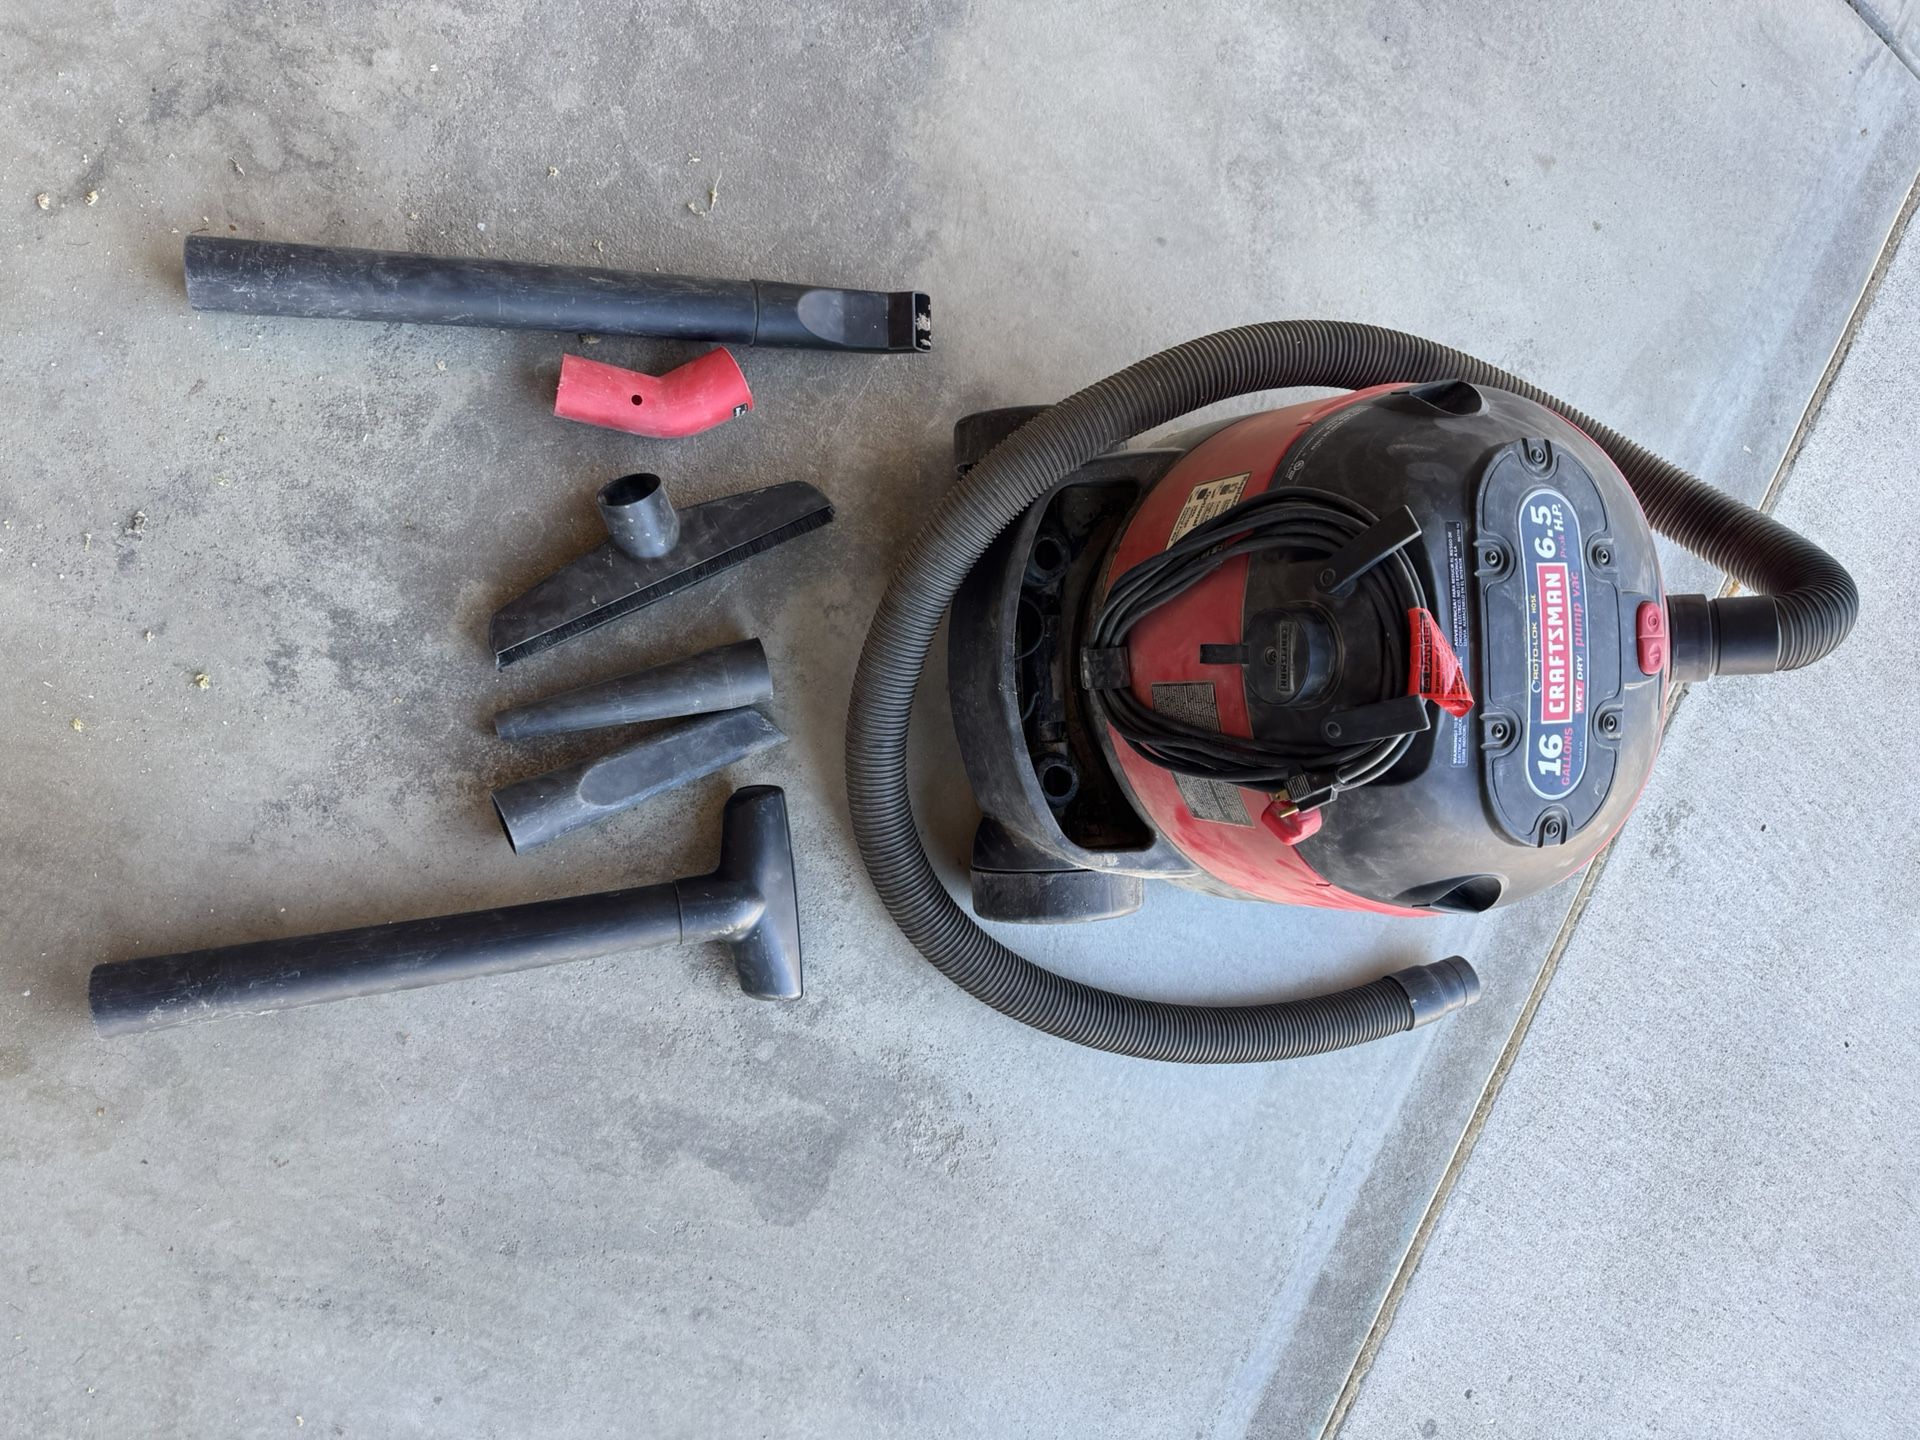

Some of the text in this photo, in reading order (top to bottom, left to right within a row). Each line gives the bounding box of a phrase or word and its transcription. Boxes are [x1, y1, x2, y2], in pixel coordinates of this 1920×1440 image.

[1530, 505, 1556, 559] 6.5
[1551, 503, 1567, 558] Peak H.P.
[1570, 571, 1580, 597] vac
[1545, 573, 1565, 713] CRAFTSMAN
[1573, 603, 1585, 647] pump
[1280, 629, 1289, 689] CRAFTSMAN
[1575, 682, 1583, 713] WET
[1537, 733, 1563, 776] 16
[1561, 727, 1573, 786] GALLONS
